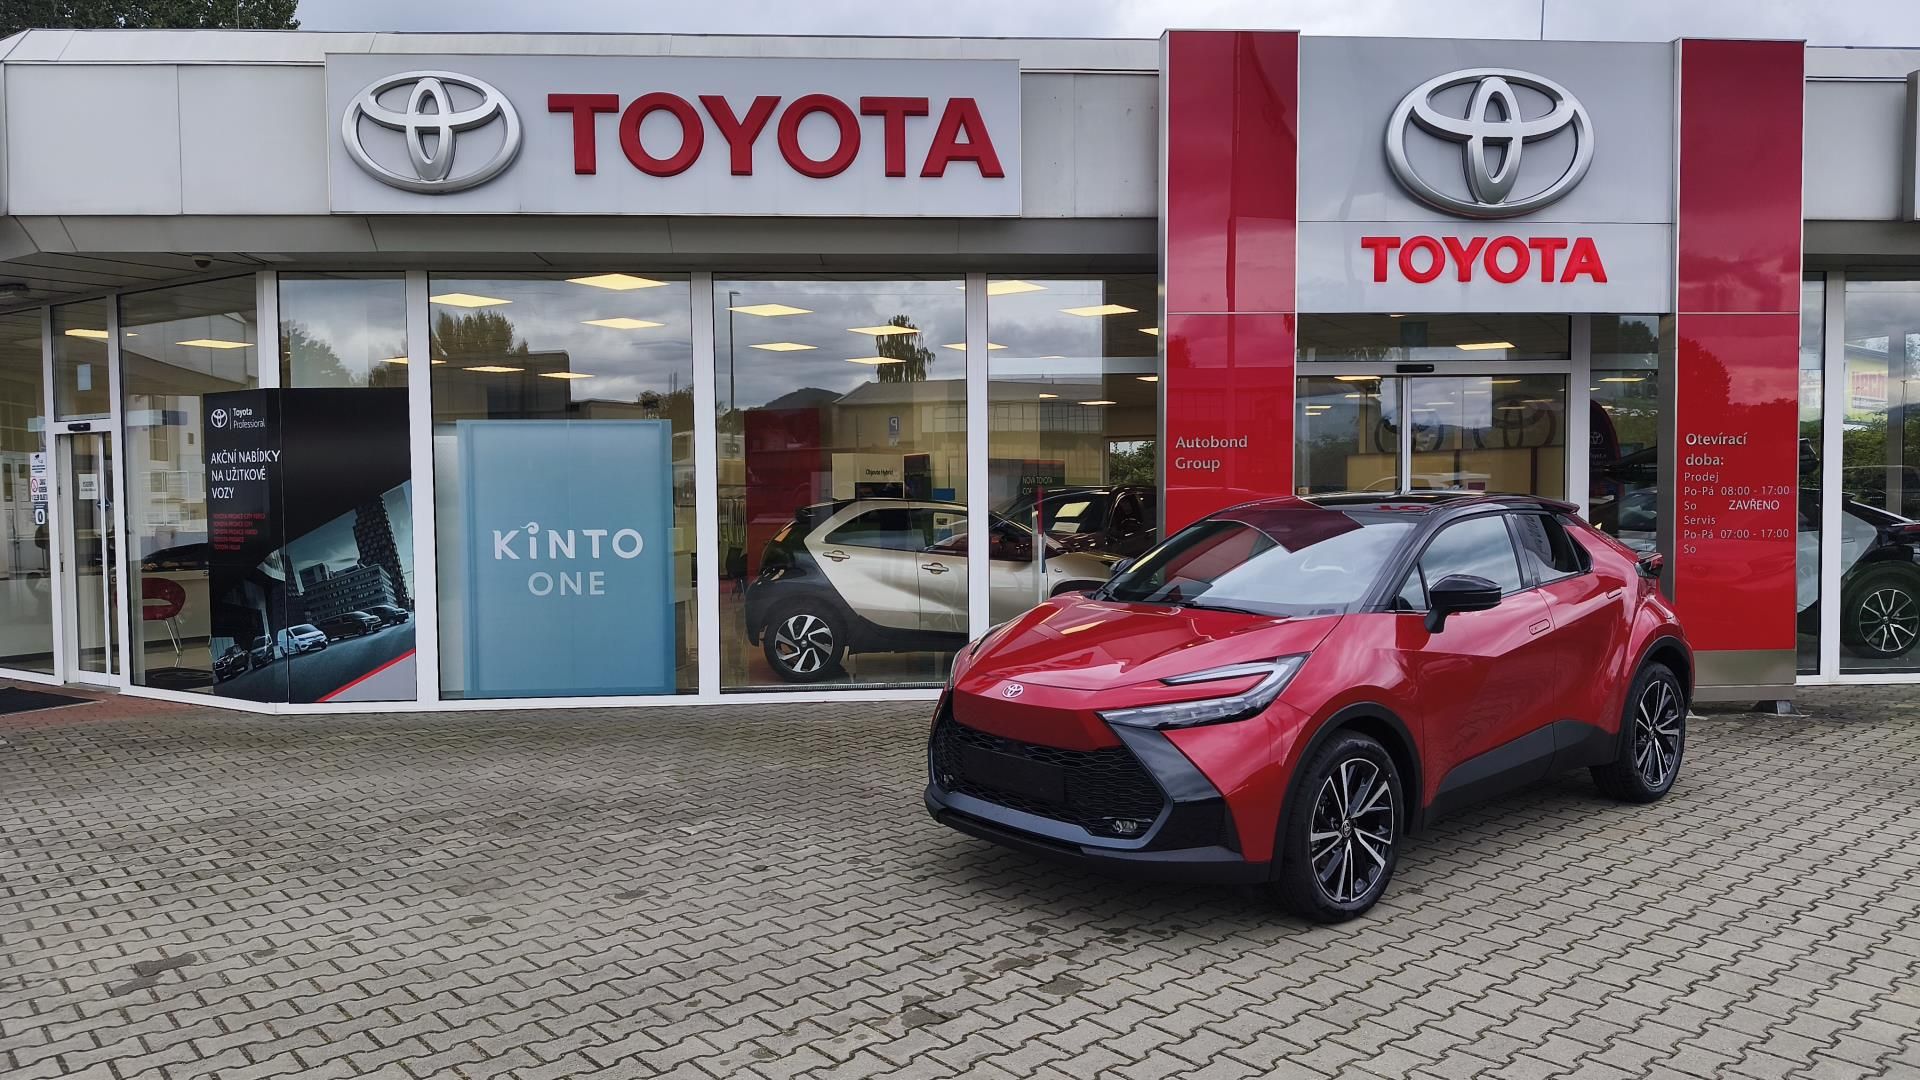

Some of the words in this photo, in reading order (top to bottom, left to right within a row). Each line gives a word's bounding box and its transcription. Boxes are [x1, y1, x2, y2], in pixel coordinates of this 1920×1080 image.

[547, 91, 1005, 179] TOYOTA
[1361, 235, 1608, 284] TOYOTA
[233, 407, 253, 418] Toyota
[233, 418, 266, 429] Professional
[1175, 434, 1248, 449] Autobond
[1685, 432, 1748, 446] Otevírací
[210, 448, 237, 465] AKČNÍ
[238, 447, 281, 464] NABÍDKY
[1685, 453, 1725, 466] doba:
[1175, 456, 1221, 473] Group
[211, 469, 225, 482] NA
[225, 465, 266, 481] UŽITKOVÉ
[1684, 471, 1720, 483] Prodej
[211, 486, 235, 499] VOZY
[1684, 486, 1714, 497] Po-Pá
[1721, 486, 1750, 496] 08:00
[1761, 485, 1790, 495] 17:00
[1684, 502, 1697, 511] So
[1728, 498, 1780, 511] ZAVŘENO
[1684, 515, 1716, 525] Servis
[1684, 529, 1714, 539] Po-Pá
[1720, 529, 1750, 539] 07:00
[1761, 528, 1790, 538] 17:00
[1683, 543, 1697, 554] So
[527, 571, 606, 597] ONE
